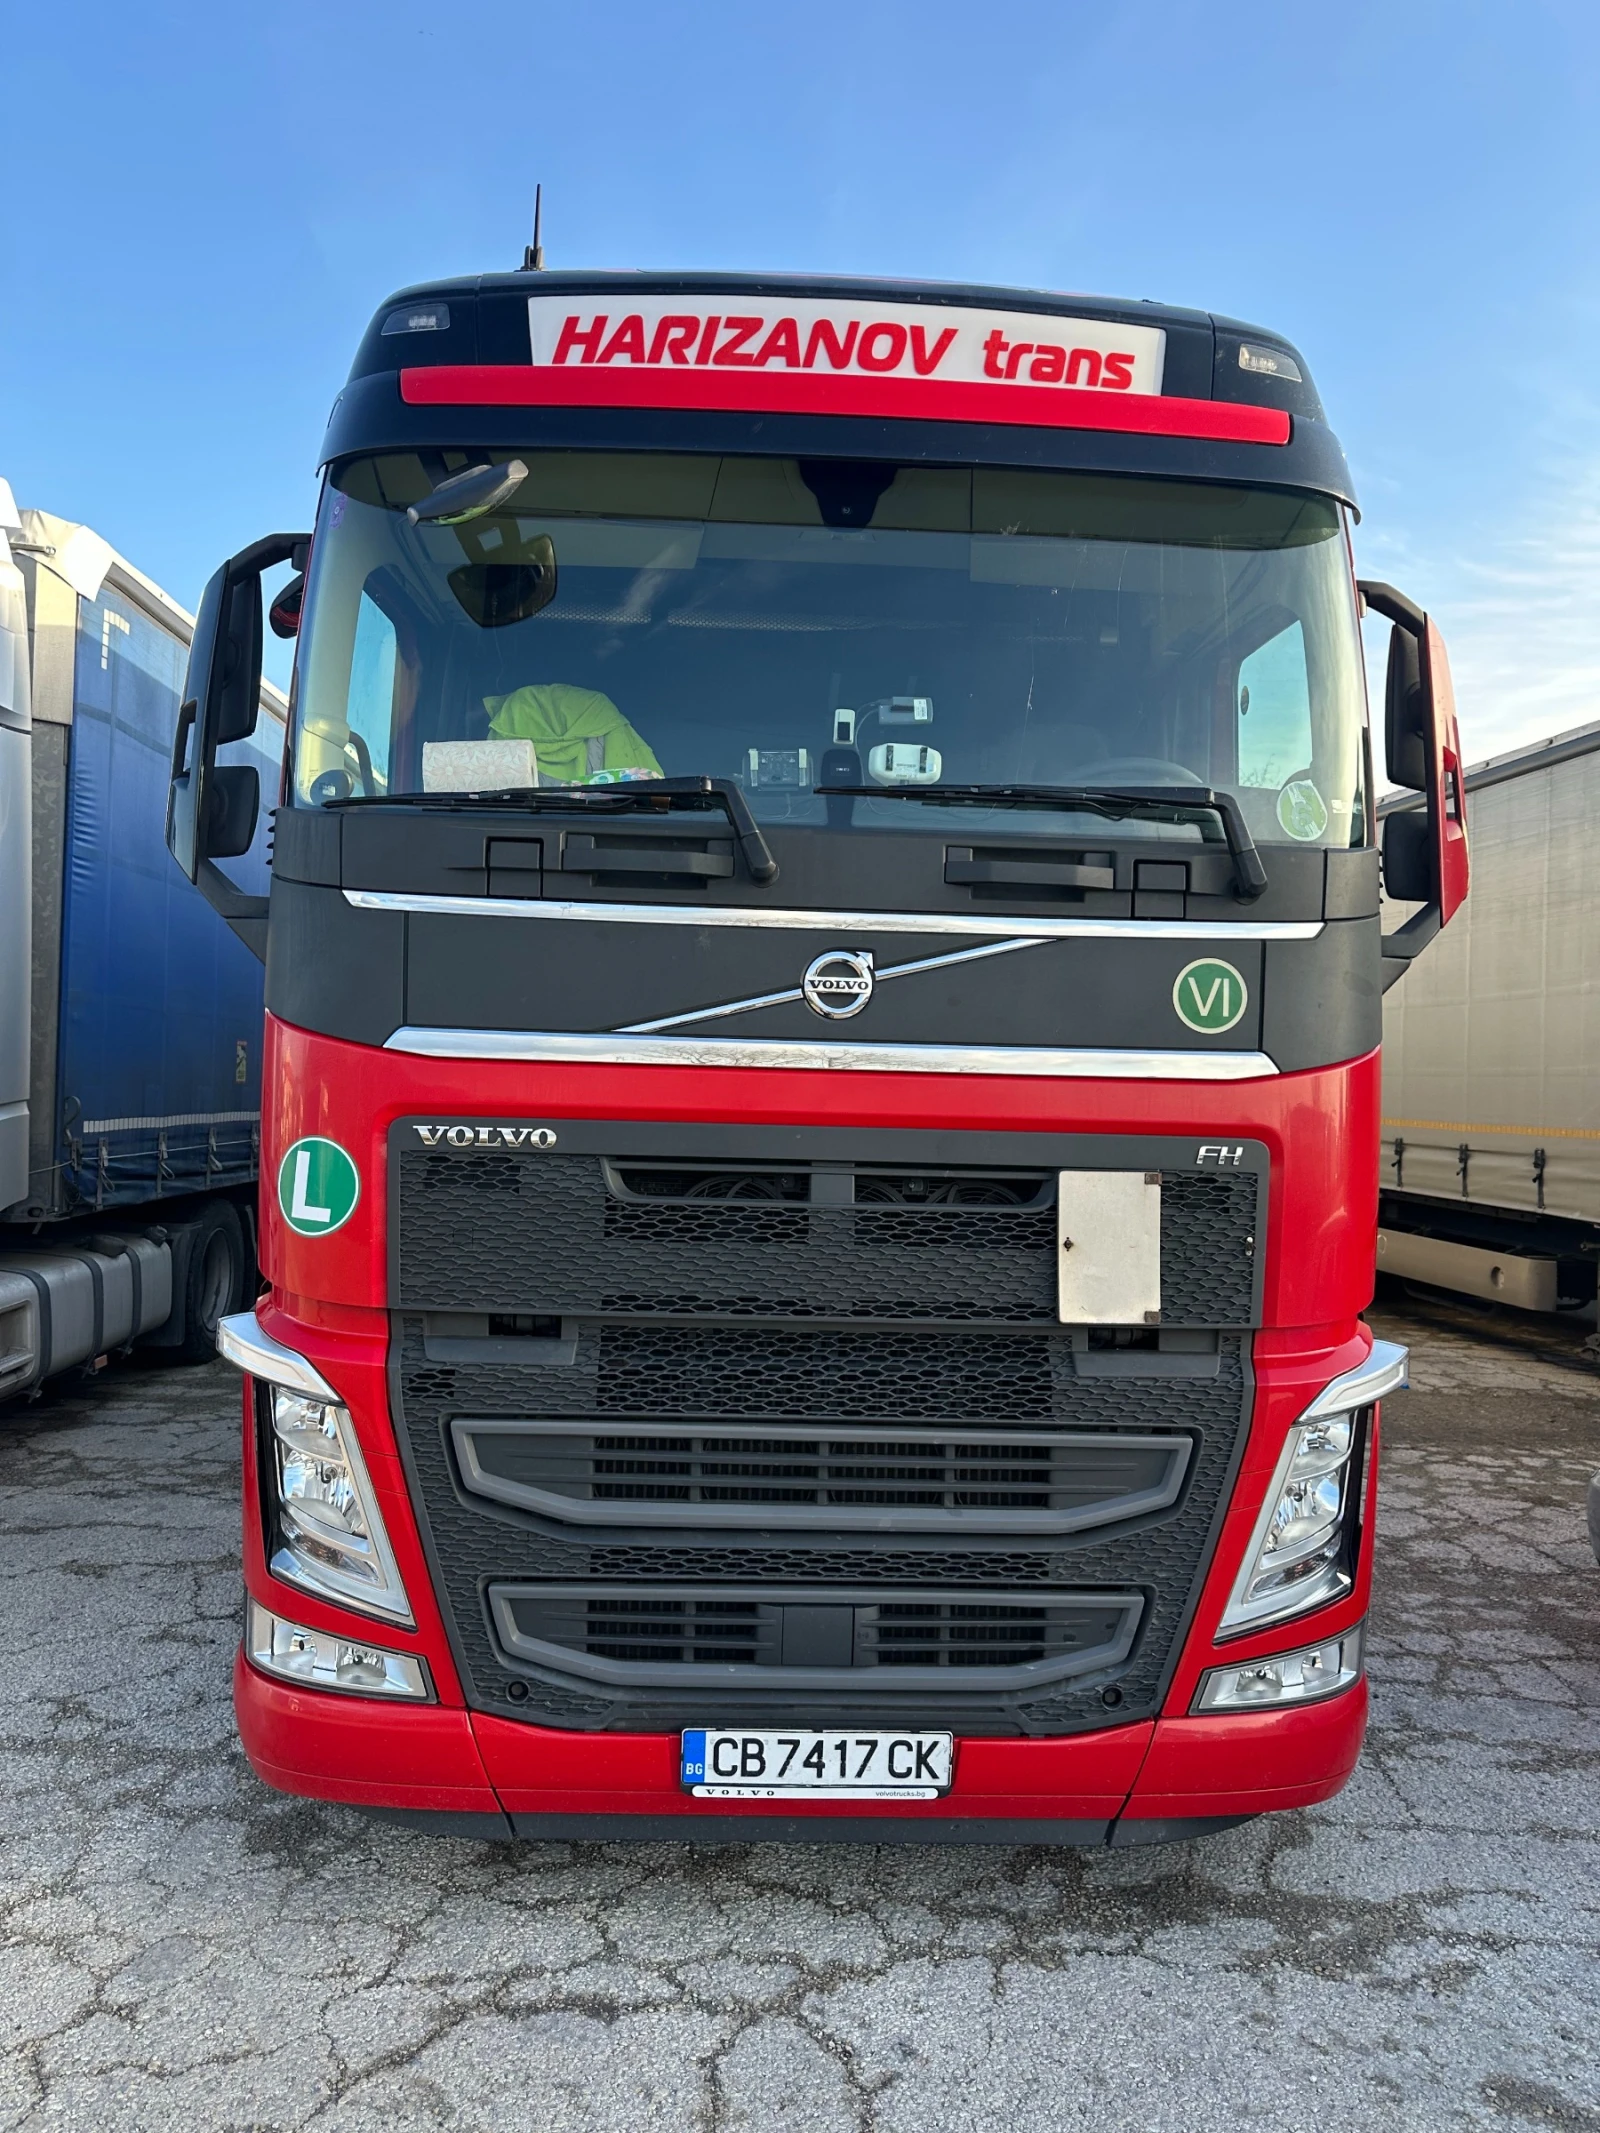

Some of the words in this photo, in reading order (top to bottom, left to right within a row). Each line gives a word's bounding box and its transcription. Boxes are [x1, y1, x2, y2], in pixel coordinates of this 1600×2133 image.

[552, 314, 958, 375] HARIZANOV
[983, 329, 1135, 390] trans
[807, 979, 869, 990] VOLVO
[1187, 976, 1230, 1017] VI
[412, 1125, 558, 1148] VOLVO
[1195, 1144, 1243, 1165] FH
[291, 1150, 331, 1223] L
[685, 1762, 703, 1775] BG
[712, 1737, 767, 1777] CB
[776, 1738, 879, 1779] 7417
[887, 1739, 940, 1779] CK
[705, 1788, 775, 1797] VOLVO
[875, 1790, 926, 1798] volvotrucks.bg
